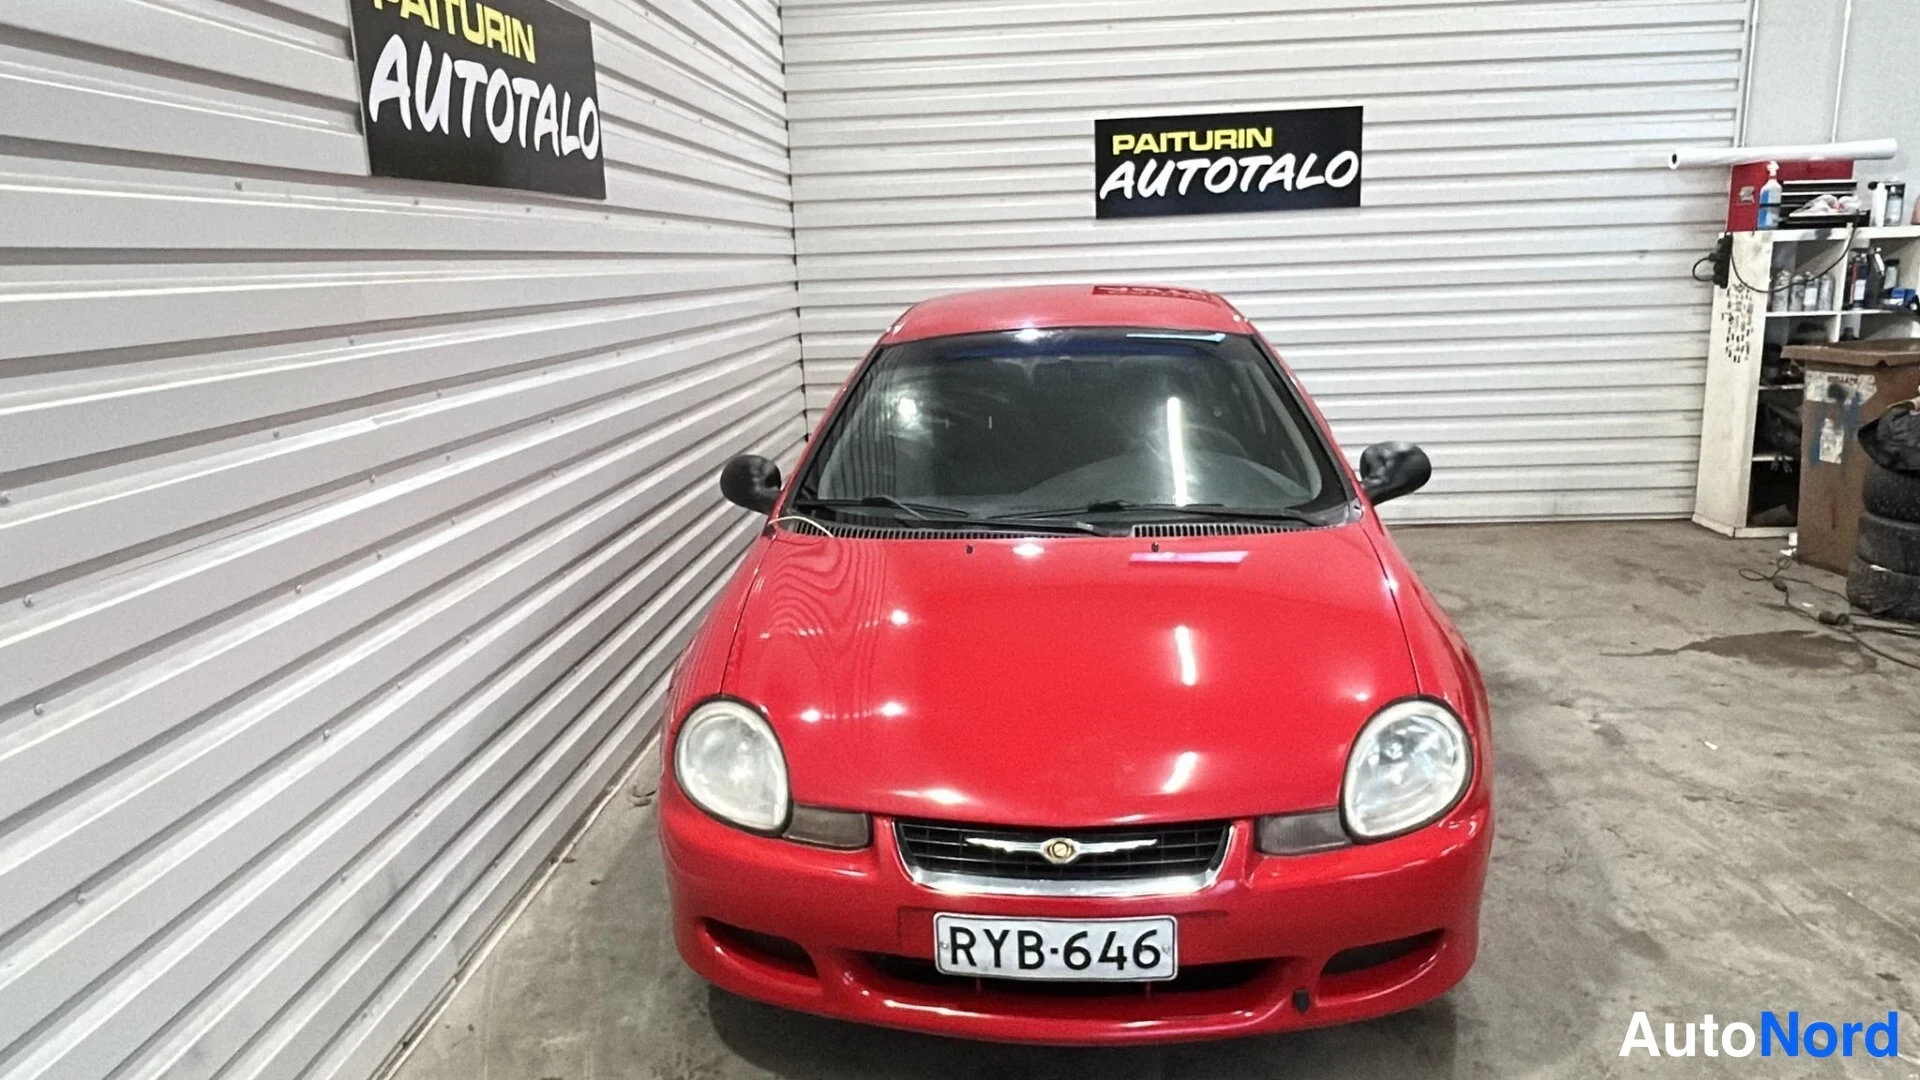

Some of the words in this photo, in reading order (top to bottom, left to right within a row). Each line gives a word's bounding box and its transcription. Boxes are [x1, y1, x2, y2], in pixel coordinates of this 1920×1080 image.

[374, 0, 536, 64] AITURIN
[369, 34, 600, 160] AUTOTALO
[1112, 127, 1273, 155] PAITURIN
[1099, 150, 1359, 199] AUTOTALO
[949, 926, 1161, 971] RYB-646
